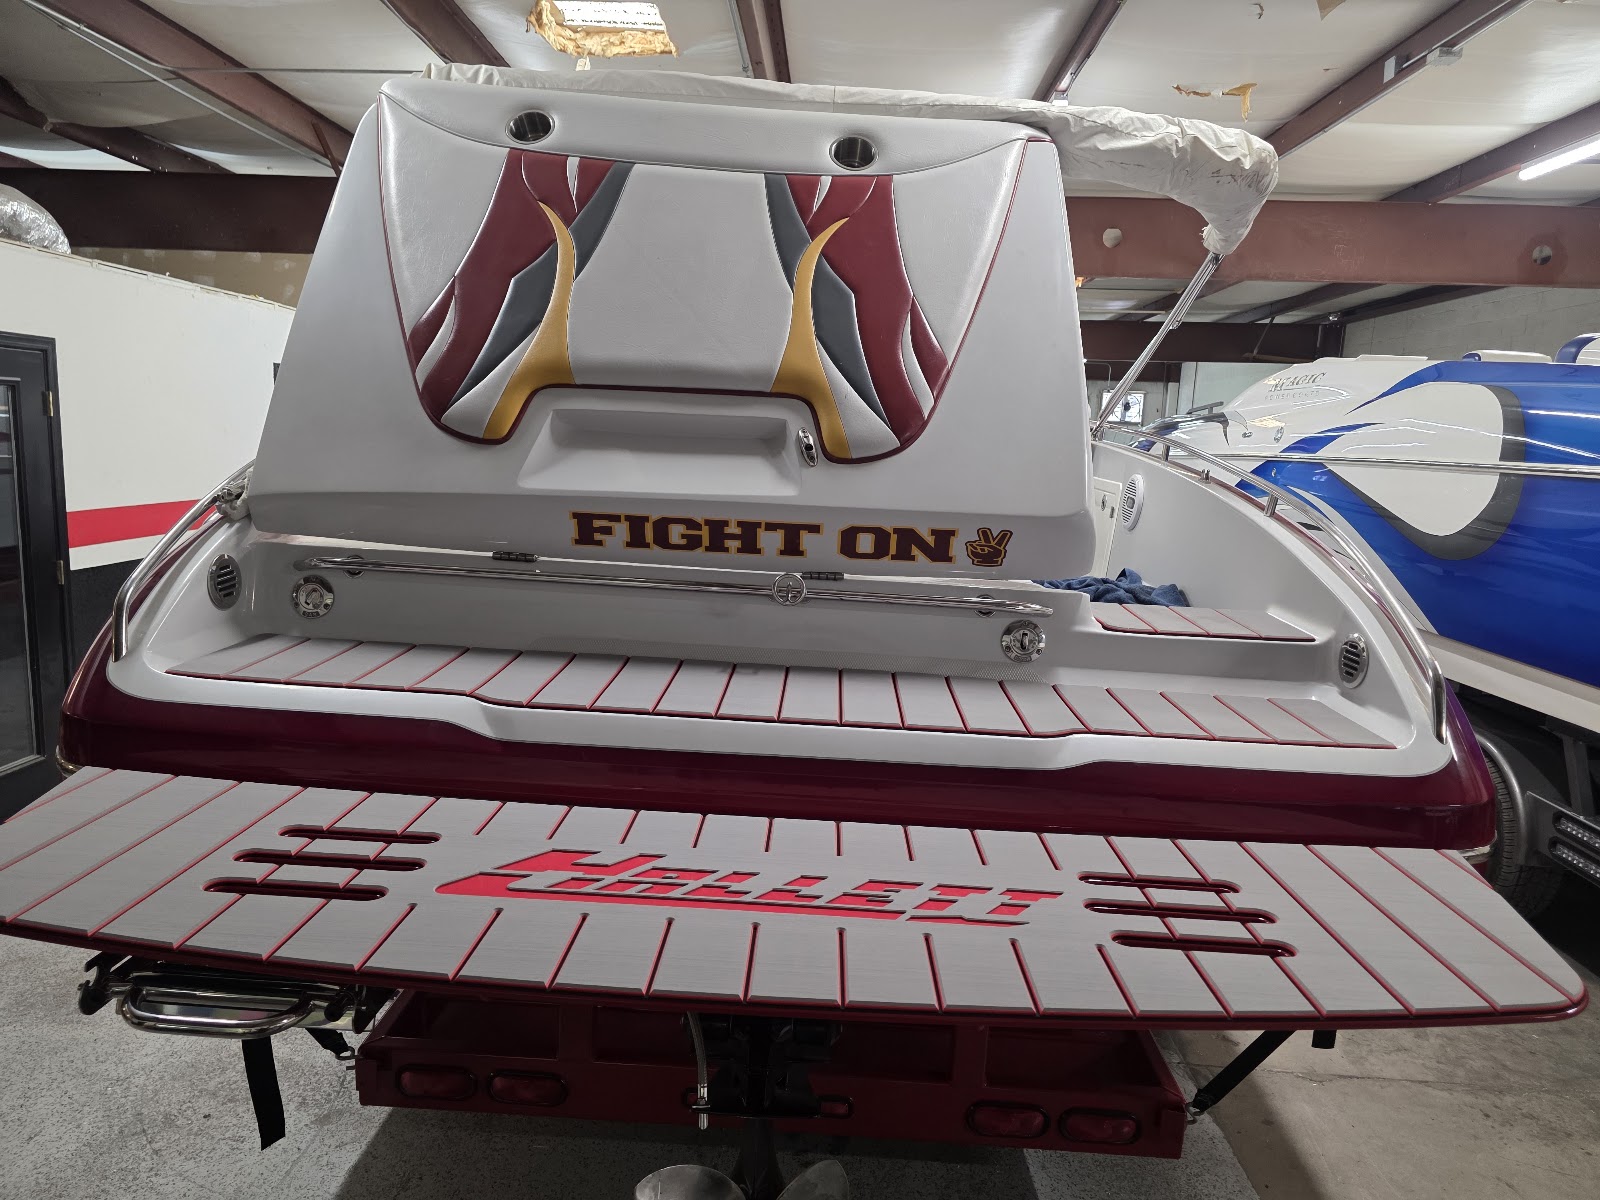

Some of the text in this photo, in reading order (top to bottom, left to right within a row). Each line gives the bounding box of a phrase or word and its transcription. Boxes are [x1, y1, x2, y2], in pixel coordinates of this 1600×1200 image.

[1268, 372, 1327, 392] MAGIC
[569, 510, 960, 564] FIGHT ON
